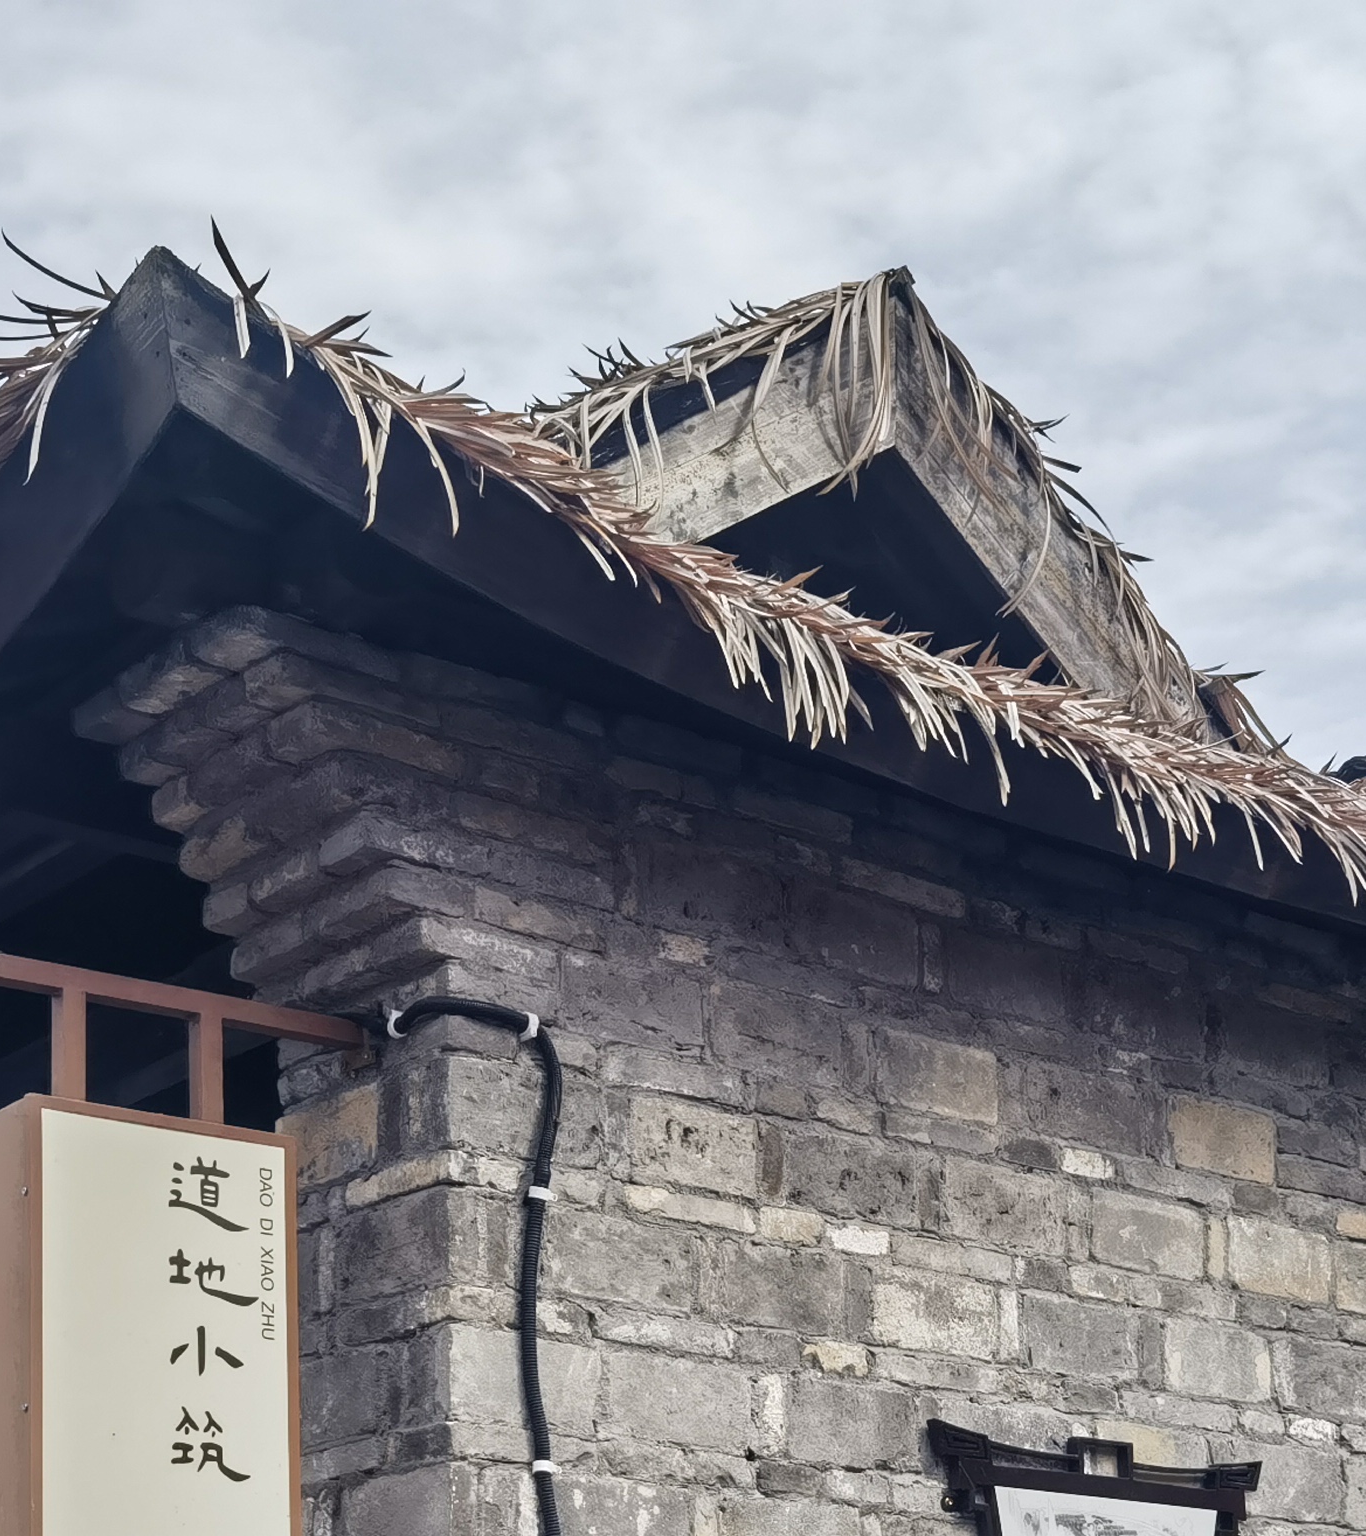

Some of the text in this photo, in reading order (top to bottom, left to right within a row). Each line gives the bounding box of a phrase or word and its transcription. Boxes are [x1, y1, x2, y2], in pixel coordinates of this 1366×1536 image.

[168, 1155, 259, 1482] 道地小筑
[259, 1167, 275, 1341] DAO DI XIAO ZHU
